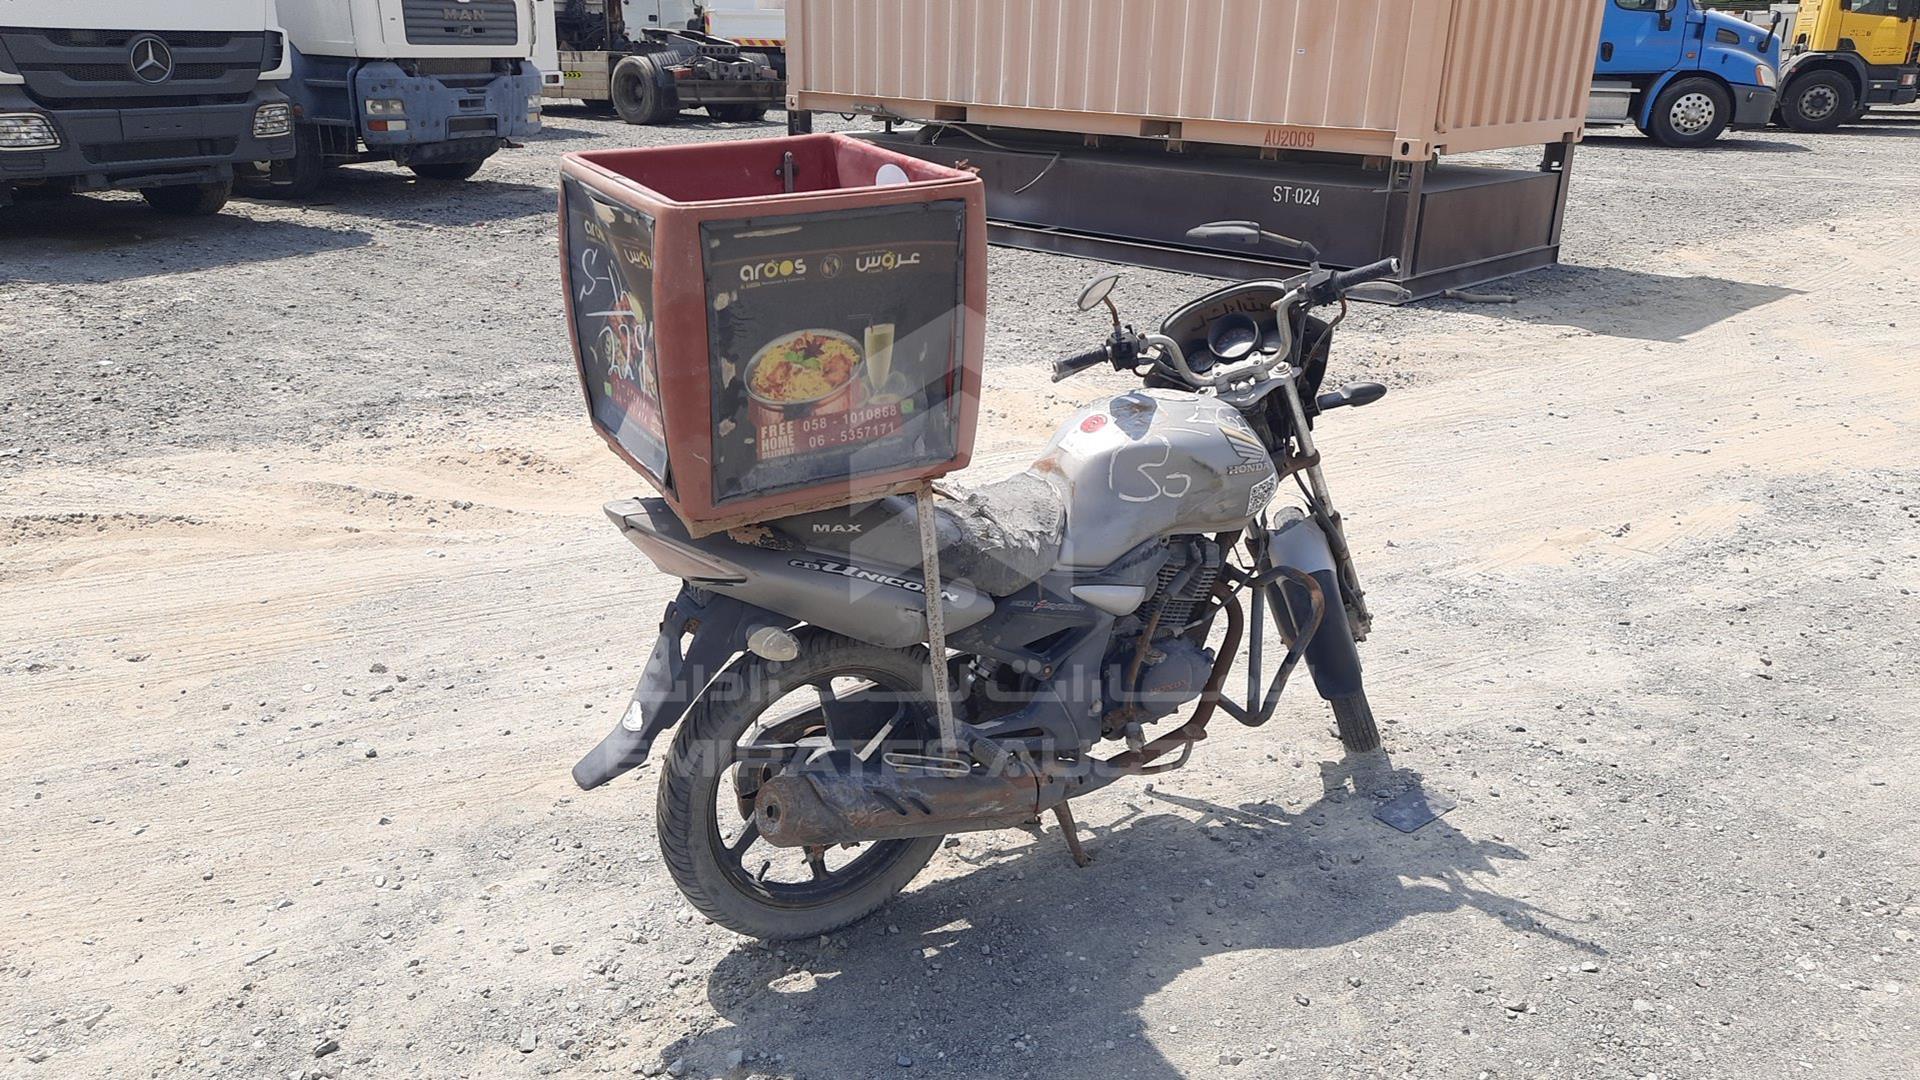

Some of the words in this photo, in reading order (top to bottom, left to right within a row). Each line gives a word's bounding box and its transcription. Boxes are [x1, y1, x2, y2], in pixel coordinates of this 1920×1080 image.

[442, 9, 485, 20] MAN
[739, 258, 807, 281] aroos
[803, 417, 827, 432] 058
[843, 405, 897, 425] 1010868
[761, 421, 795, 439] FREE
[808, 435, 825, 449] 06
[840, 422, 895, 442] 5357171
[761, 434, 796, 452] HOME
[1227, 463, 1270, 475] HONDA
[812, 524, 862, 533] MAX
[819, 561, 959, 601] UNICON
